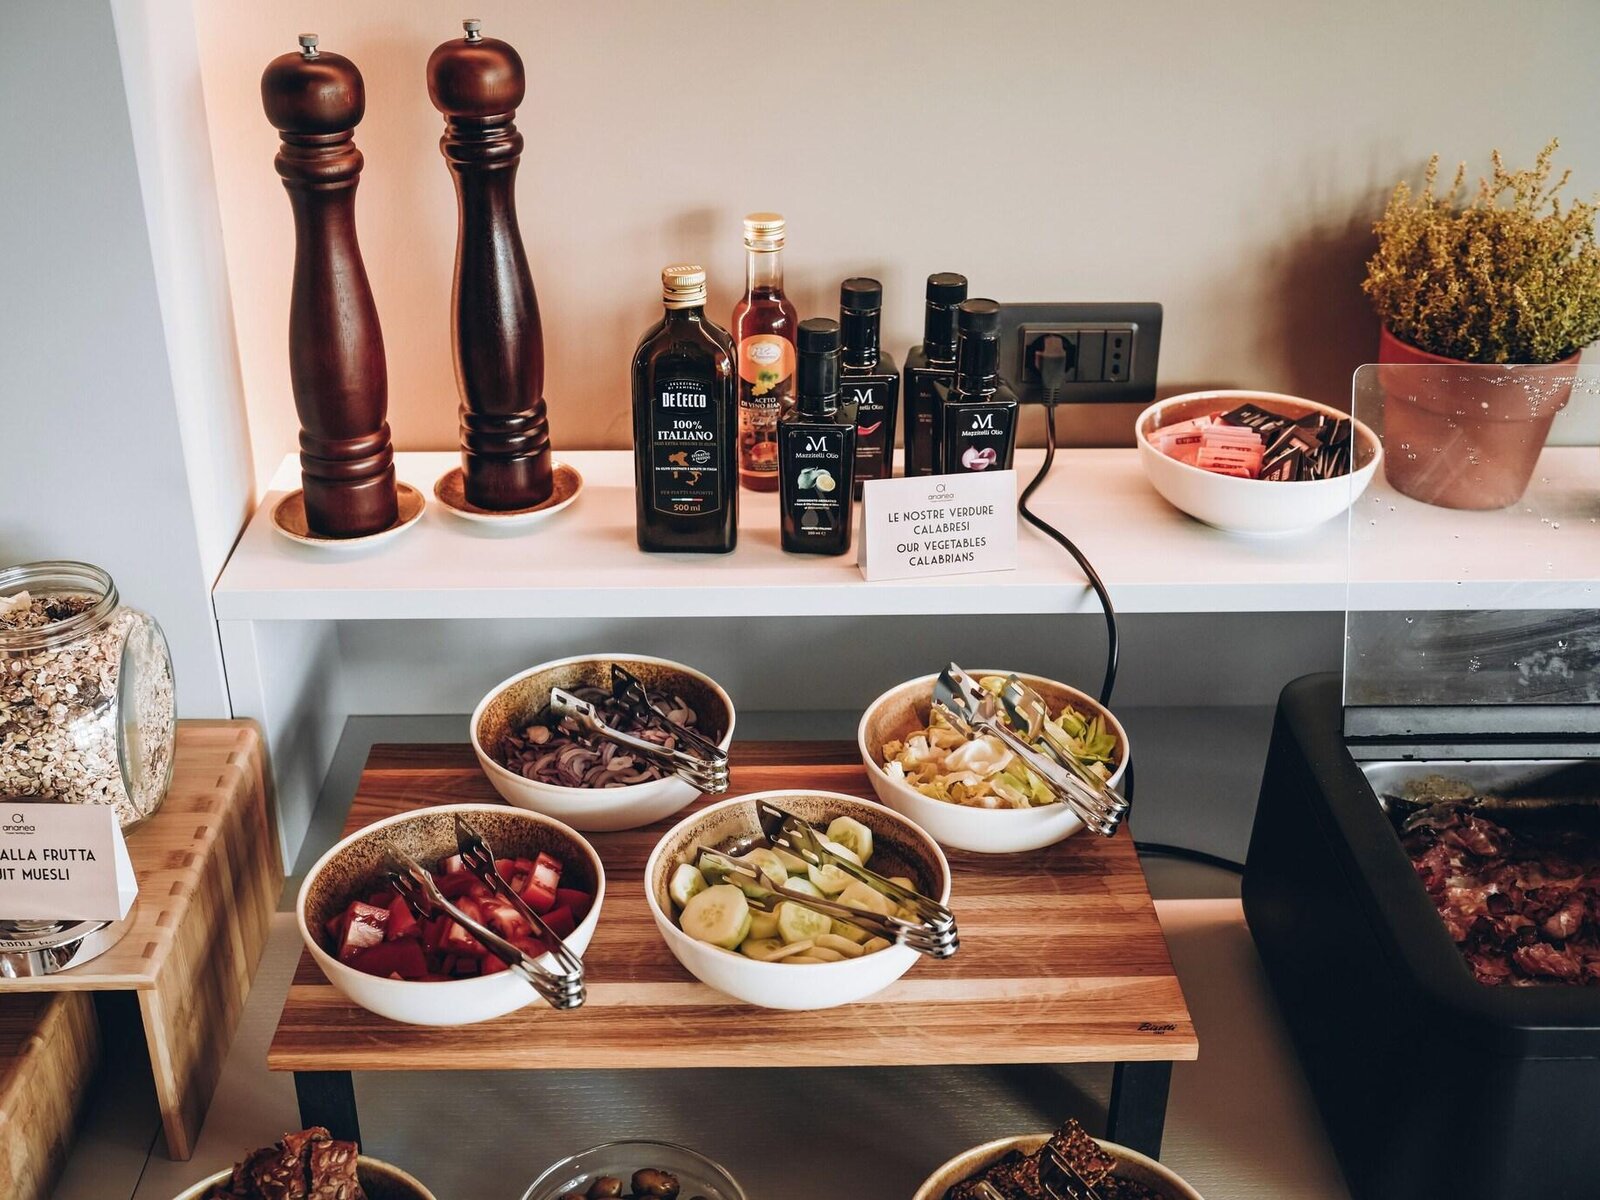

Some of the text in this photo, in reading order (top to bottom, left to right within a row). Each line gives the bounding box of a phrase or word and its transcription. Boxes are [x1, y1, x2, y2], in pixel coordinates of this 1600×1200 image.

[673, 420, 702, 429] 100%
[657, 431, 713, 441] ITALIANO
[928, 493, 955, 501] ananea
[888, 505, 994, 523] LE NOSTRE VERDURE
[913, 521, 970, 535] CALABRESI
[896, 537, 987, 553] OUR VEGETABLES
[909, 552, 975, 567] CALABRIANS
[0, 849, 96, 861] ALLA FRUTTA
[22, 868, 70, 880] MUESLI
